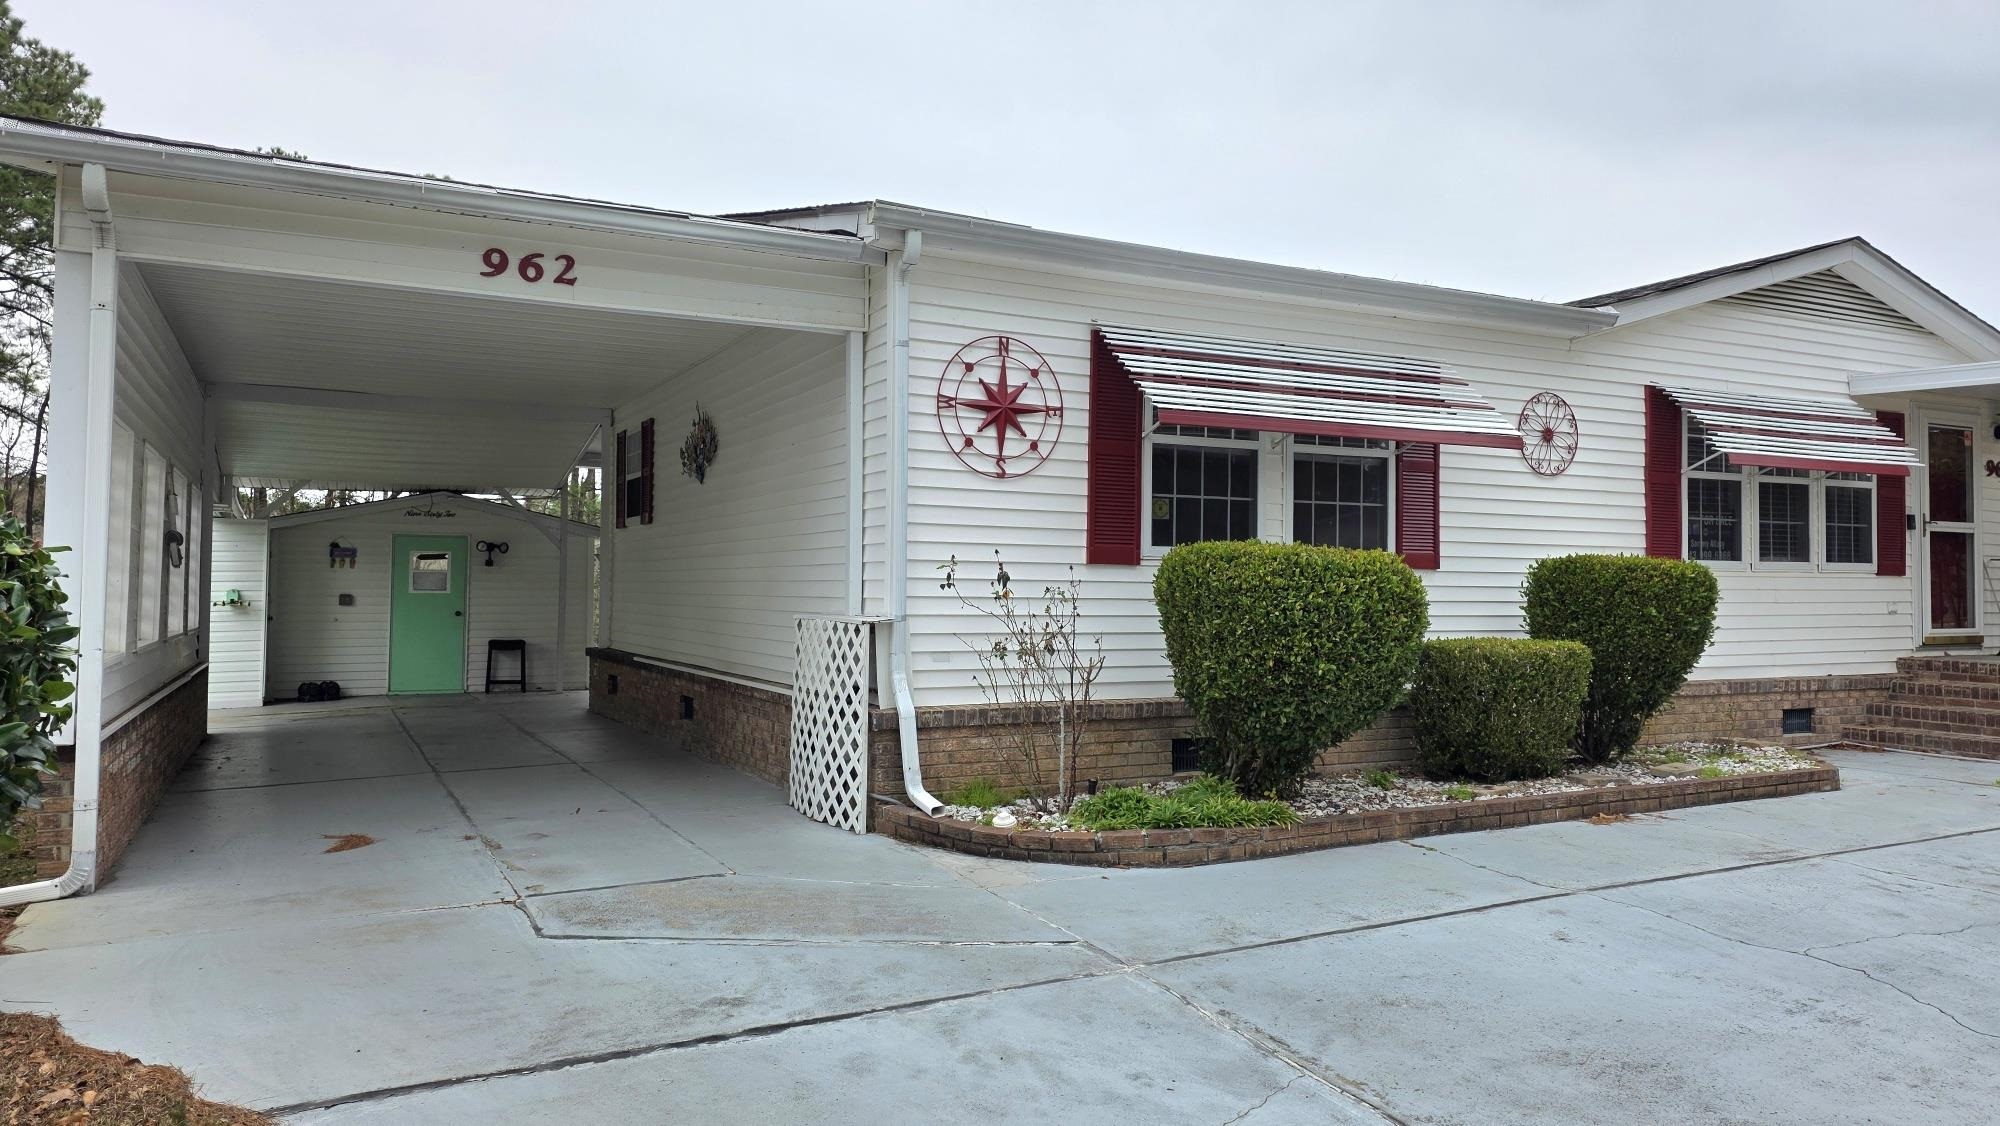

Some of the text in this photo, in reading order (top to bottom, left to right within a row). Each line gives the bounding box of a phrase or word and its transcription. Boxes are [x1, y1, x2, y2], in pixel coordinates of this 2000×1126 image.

[479, 247, 577, 286] 962
[998, 337, 1010, 357] N
[996, 458, 1007, 478] S
